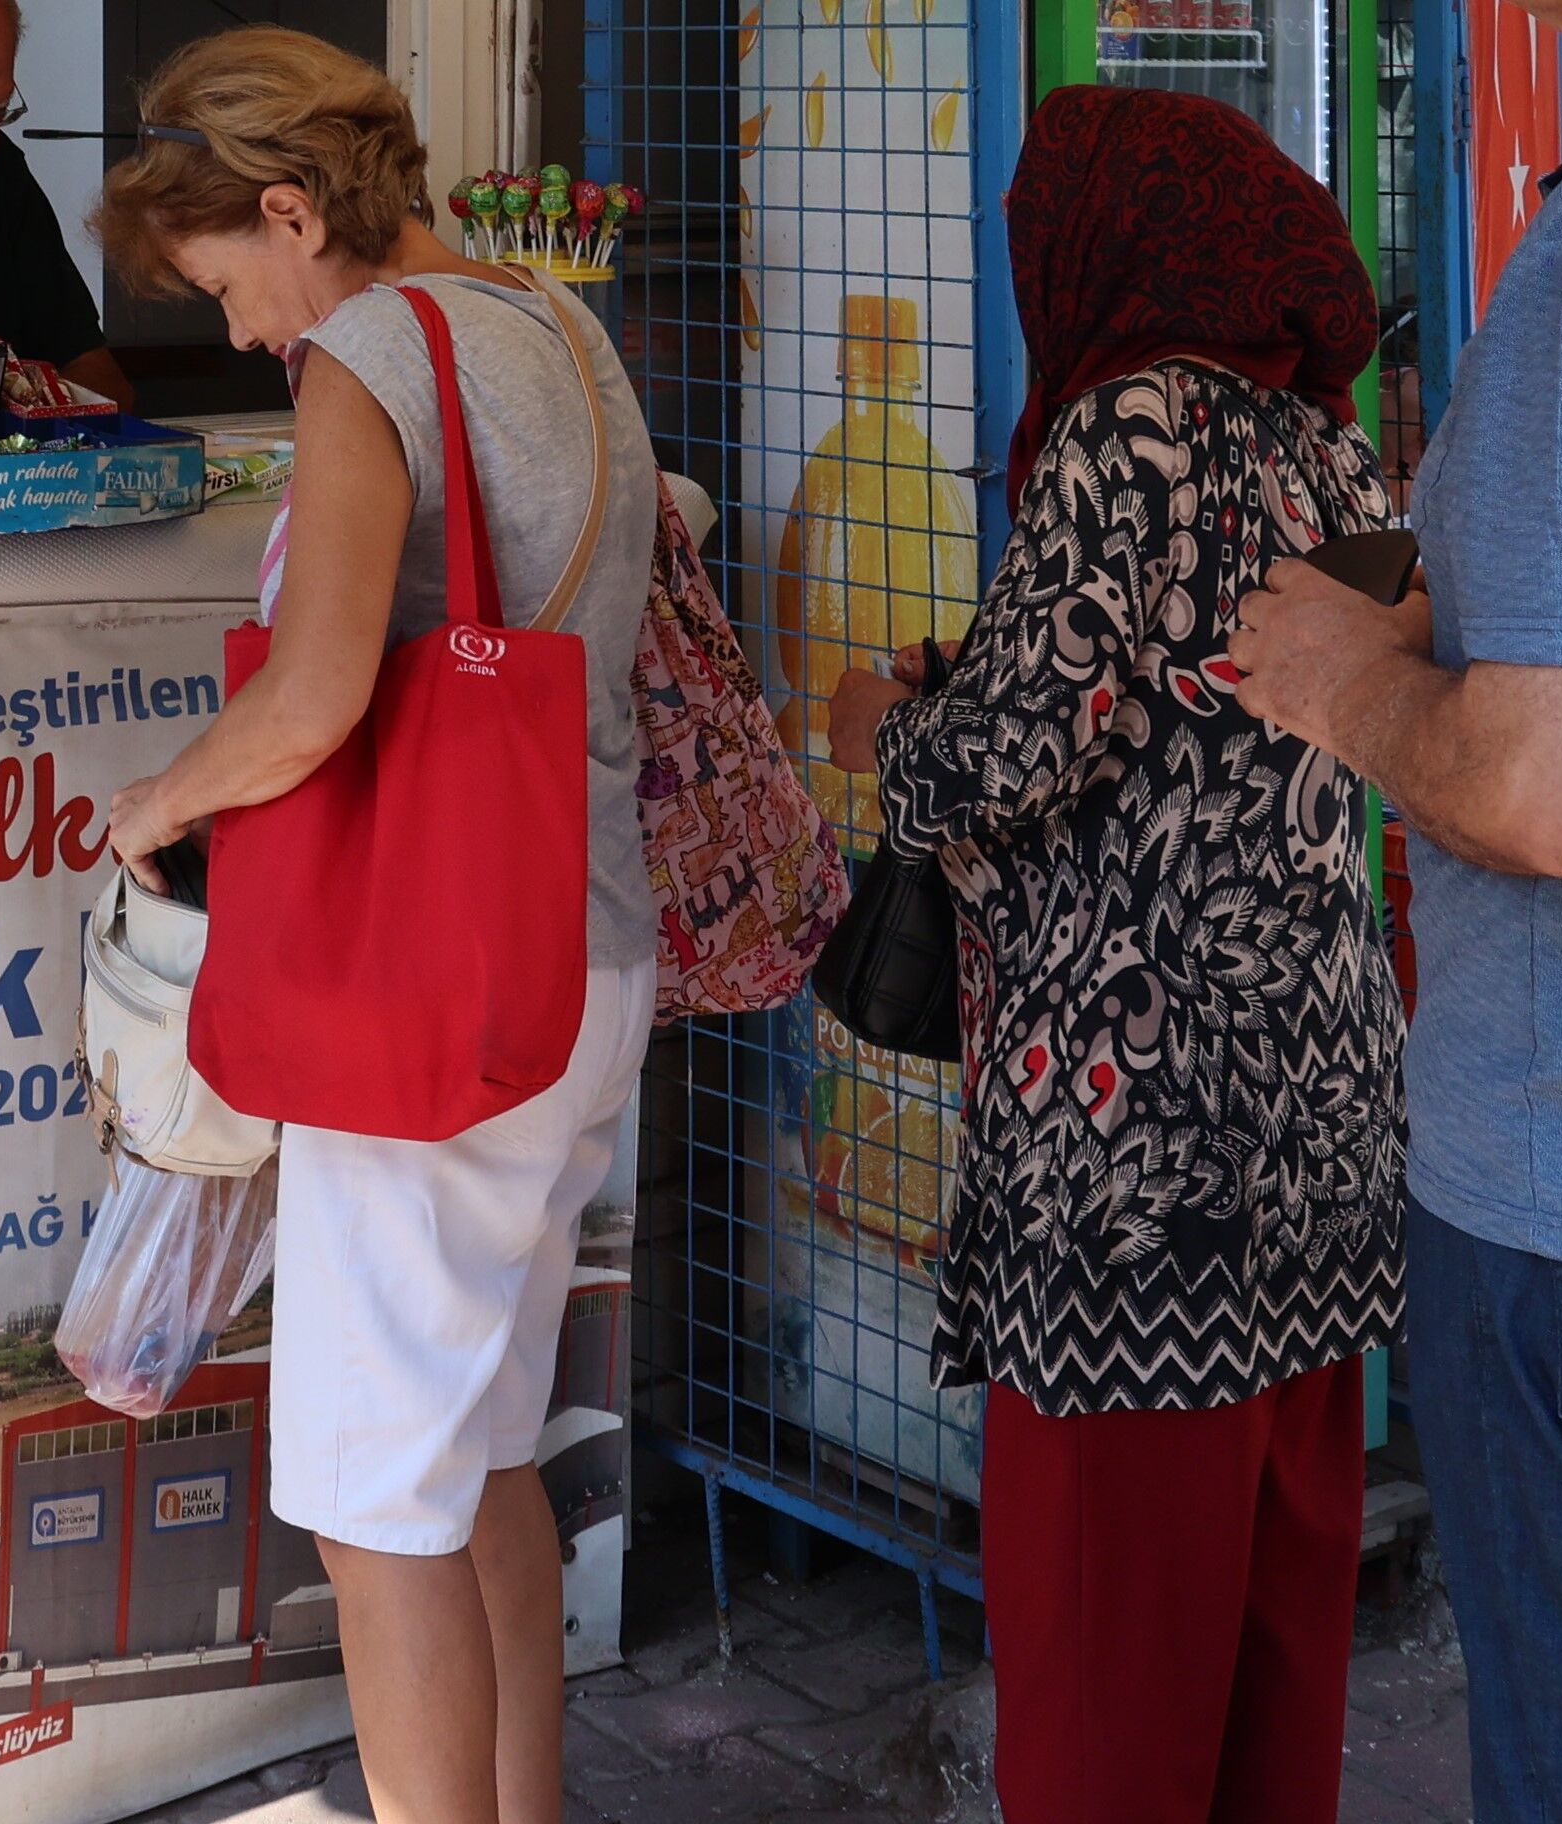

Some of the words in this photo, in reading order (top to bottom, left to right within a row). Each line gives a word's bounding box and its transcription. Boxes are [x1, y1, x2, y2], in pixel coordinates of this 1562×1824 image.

[14, 460, 80, 482] rahatla
[21, 487, 88, 510] hayatta
[455, 662, 497, 677] ALGIDA
[182, 1487, 213, 1503] HALK
[181, 1501, 221, 1519] EKMEK
